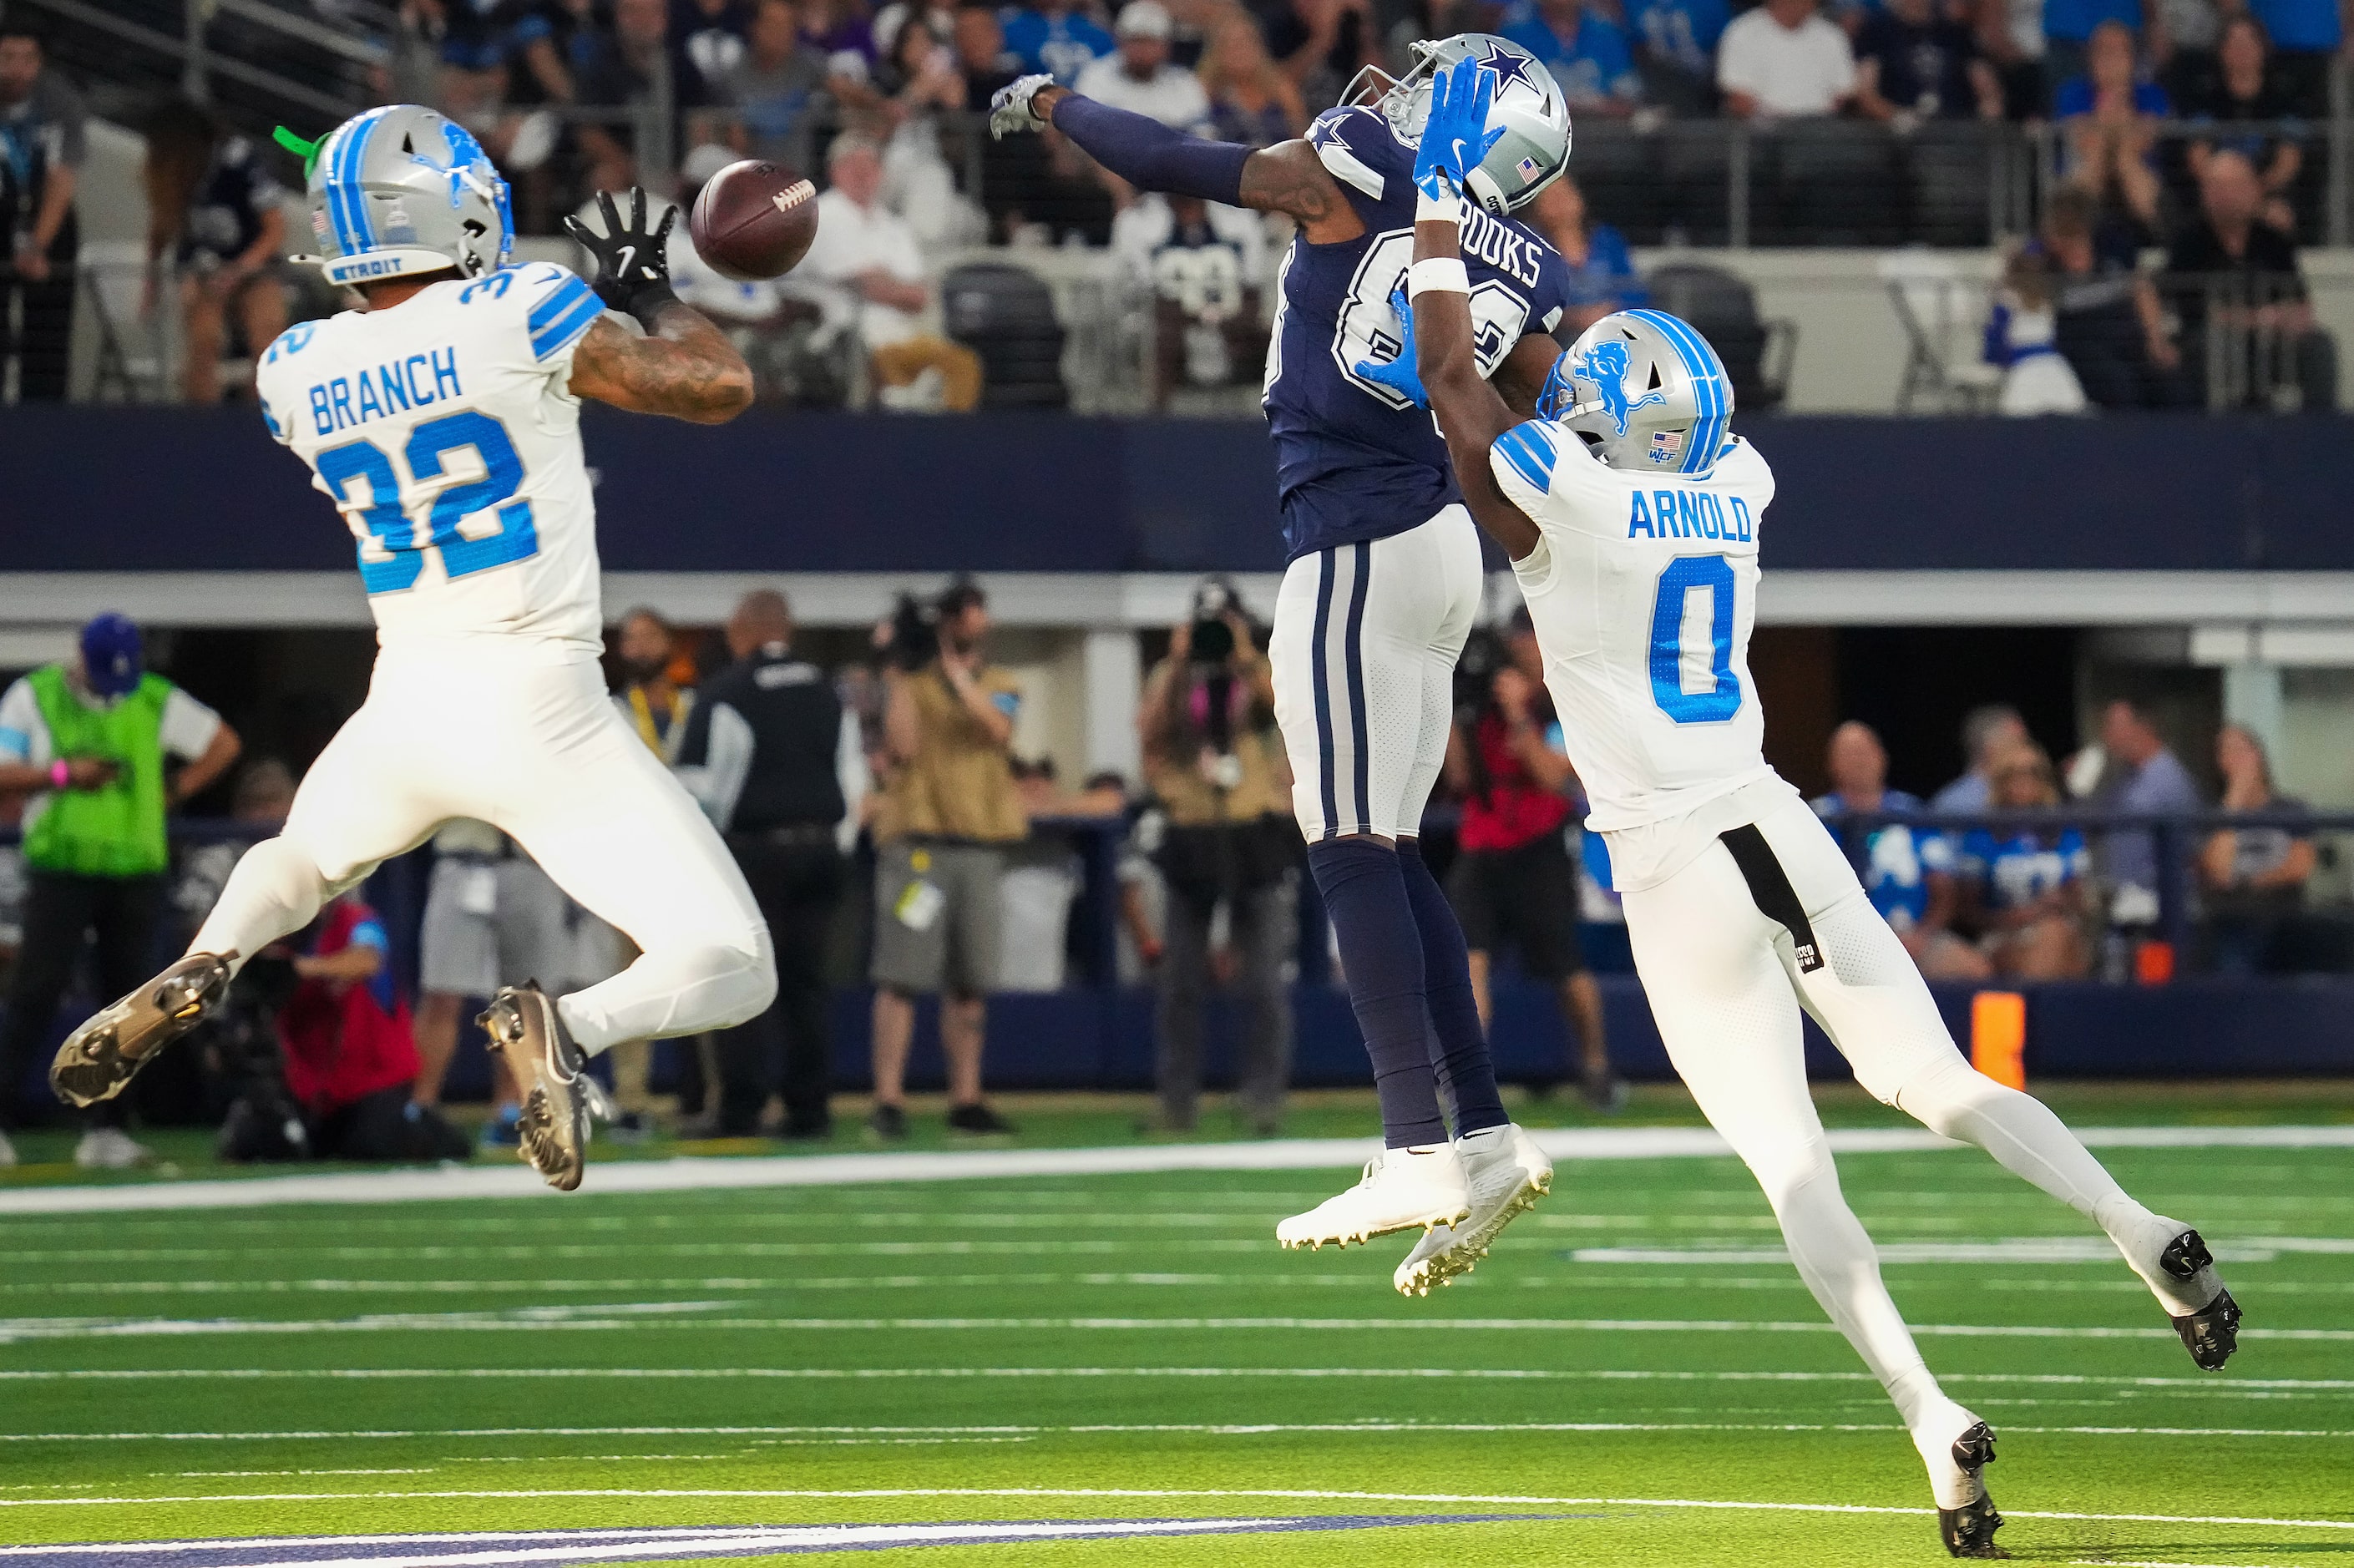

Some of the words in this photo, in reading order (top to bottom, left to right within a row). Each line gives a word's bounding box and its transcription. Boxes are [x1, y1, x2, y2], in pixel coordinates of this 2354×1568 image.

[1458, 195, 1543, 289] ROOKS
[309, 346, 462, 436] BRANCH
[1648, 448, 1678, 462] WCF
[316, 407, 541, 599] 32
[1628, 490, 1752, 543] ARNOLD
[1644, 550, 1746, 728] 0
